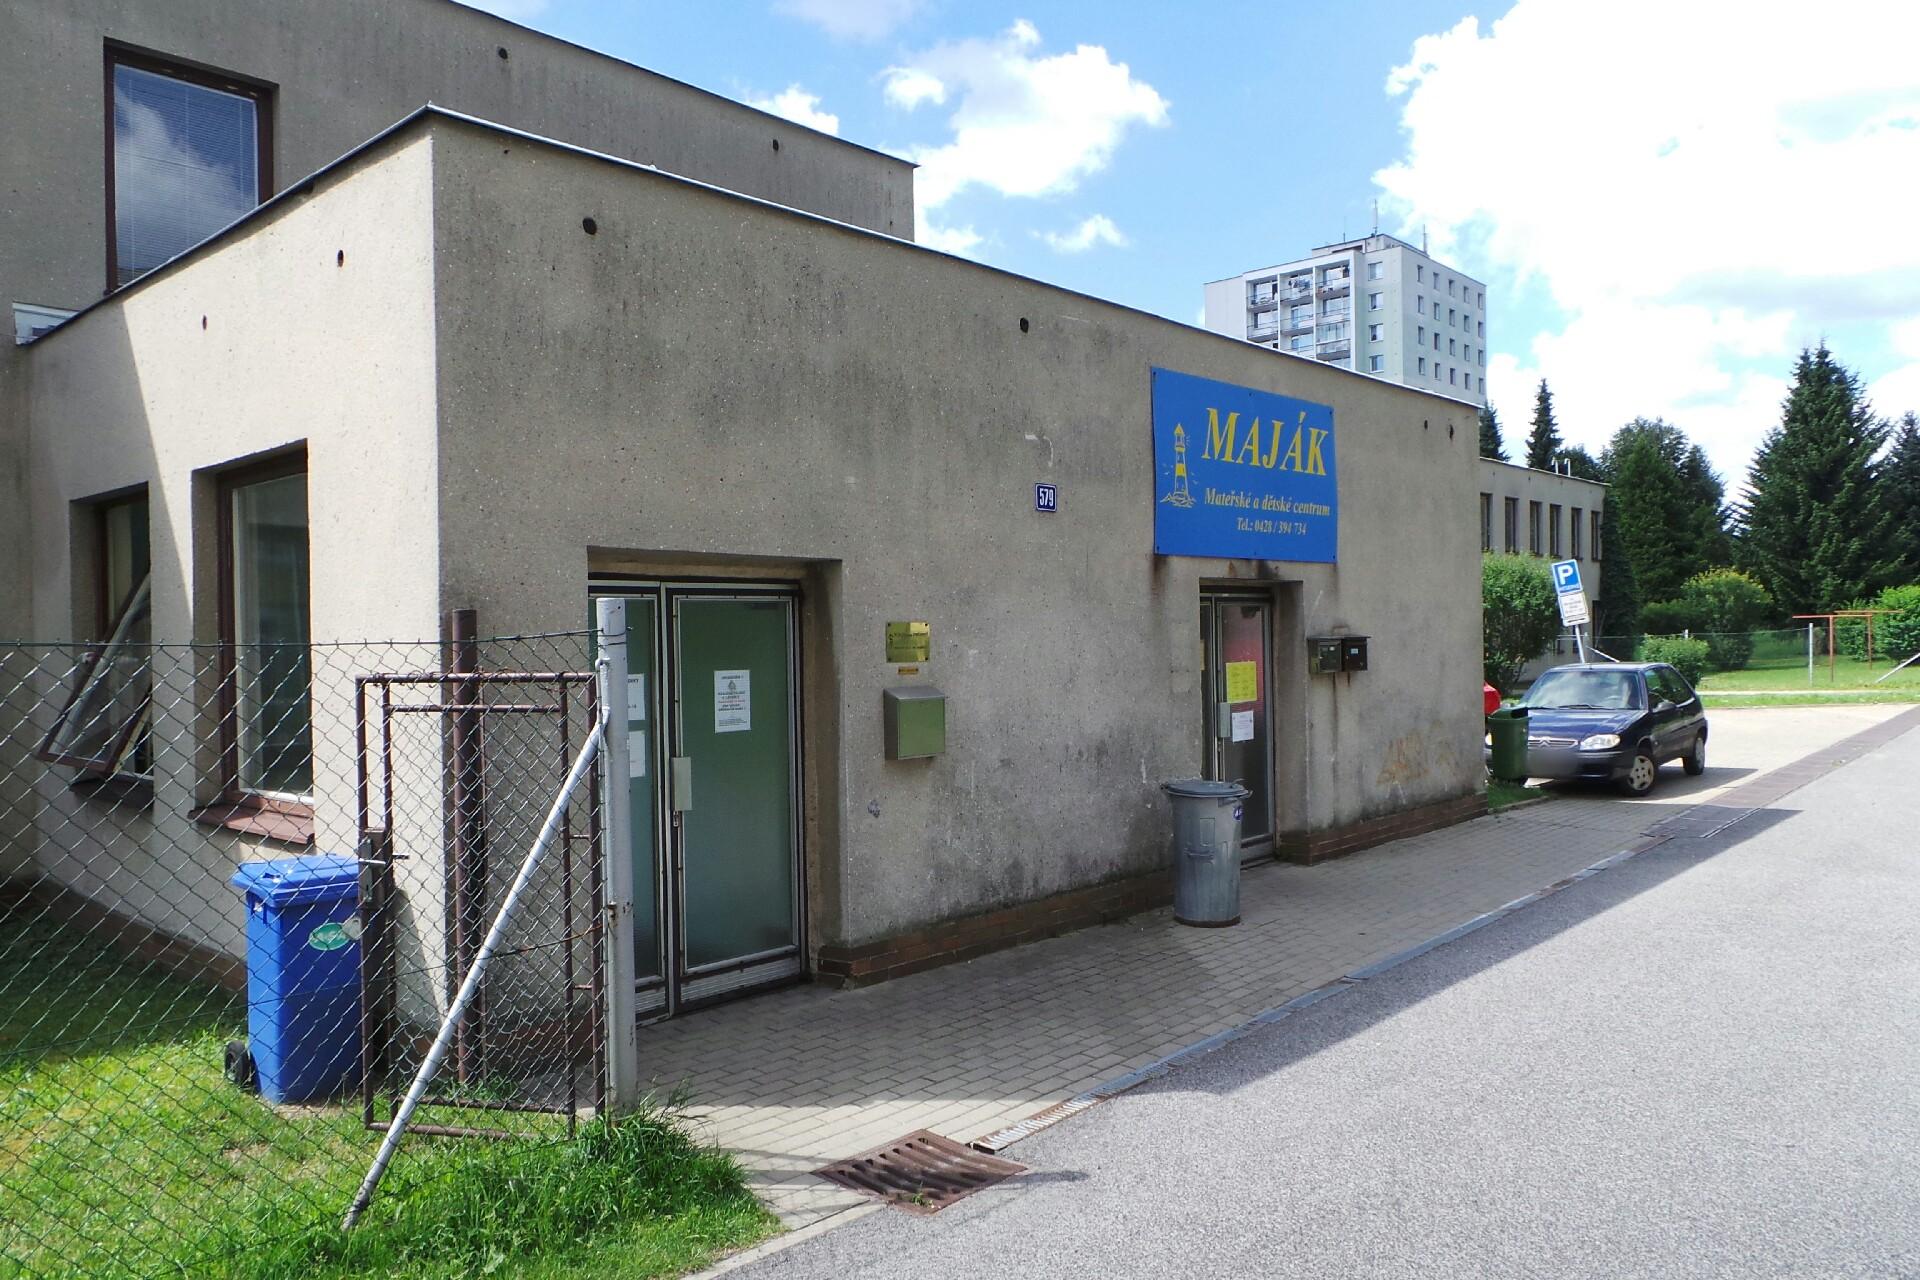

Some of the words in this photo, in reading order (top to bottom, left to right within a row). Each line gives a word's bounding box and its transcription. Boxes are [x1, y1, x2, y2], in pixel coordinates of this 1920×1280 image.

[1201, 407, 1328, 476] MAJÁK
[1039, 488, 1053, 507] 579
[1205, 487, 1251, 508] Mateřské
[1253, 497, 1259, 509] a
[1262, 494, 1292, 513] dětské
[1293, 502, 1330, 516] centrum
[1237, 517, 1253, 532] Tel.:
[1558, 565, 1573, 585] P
